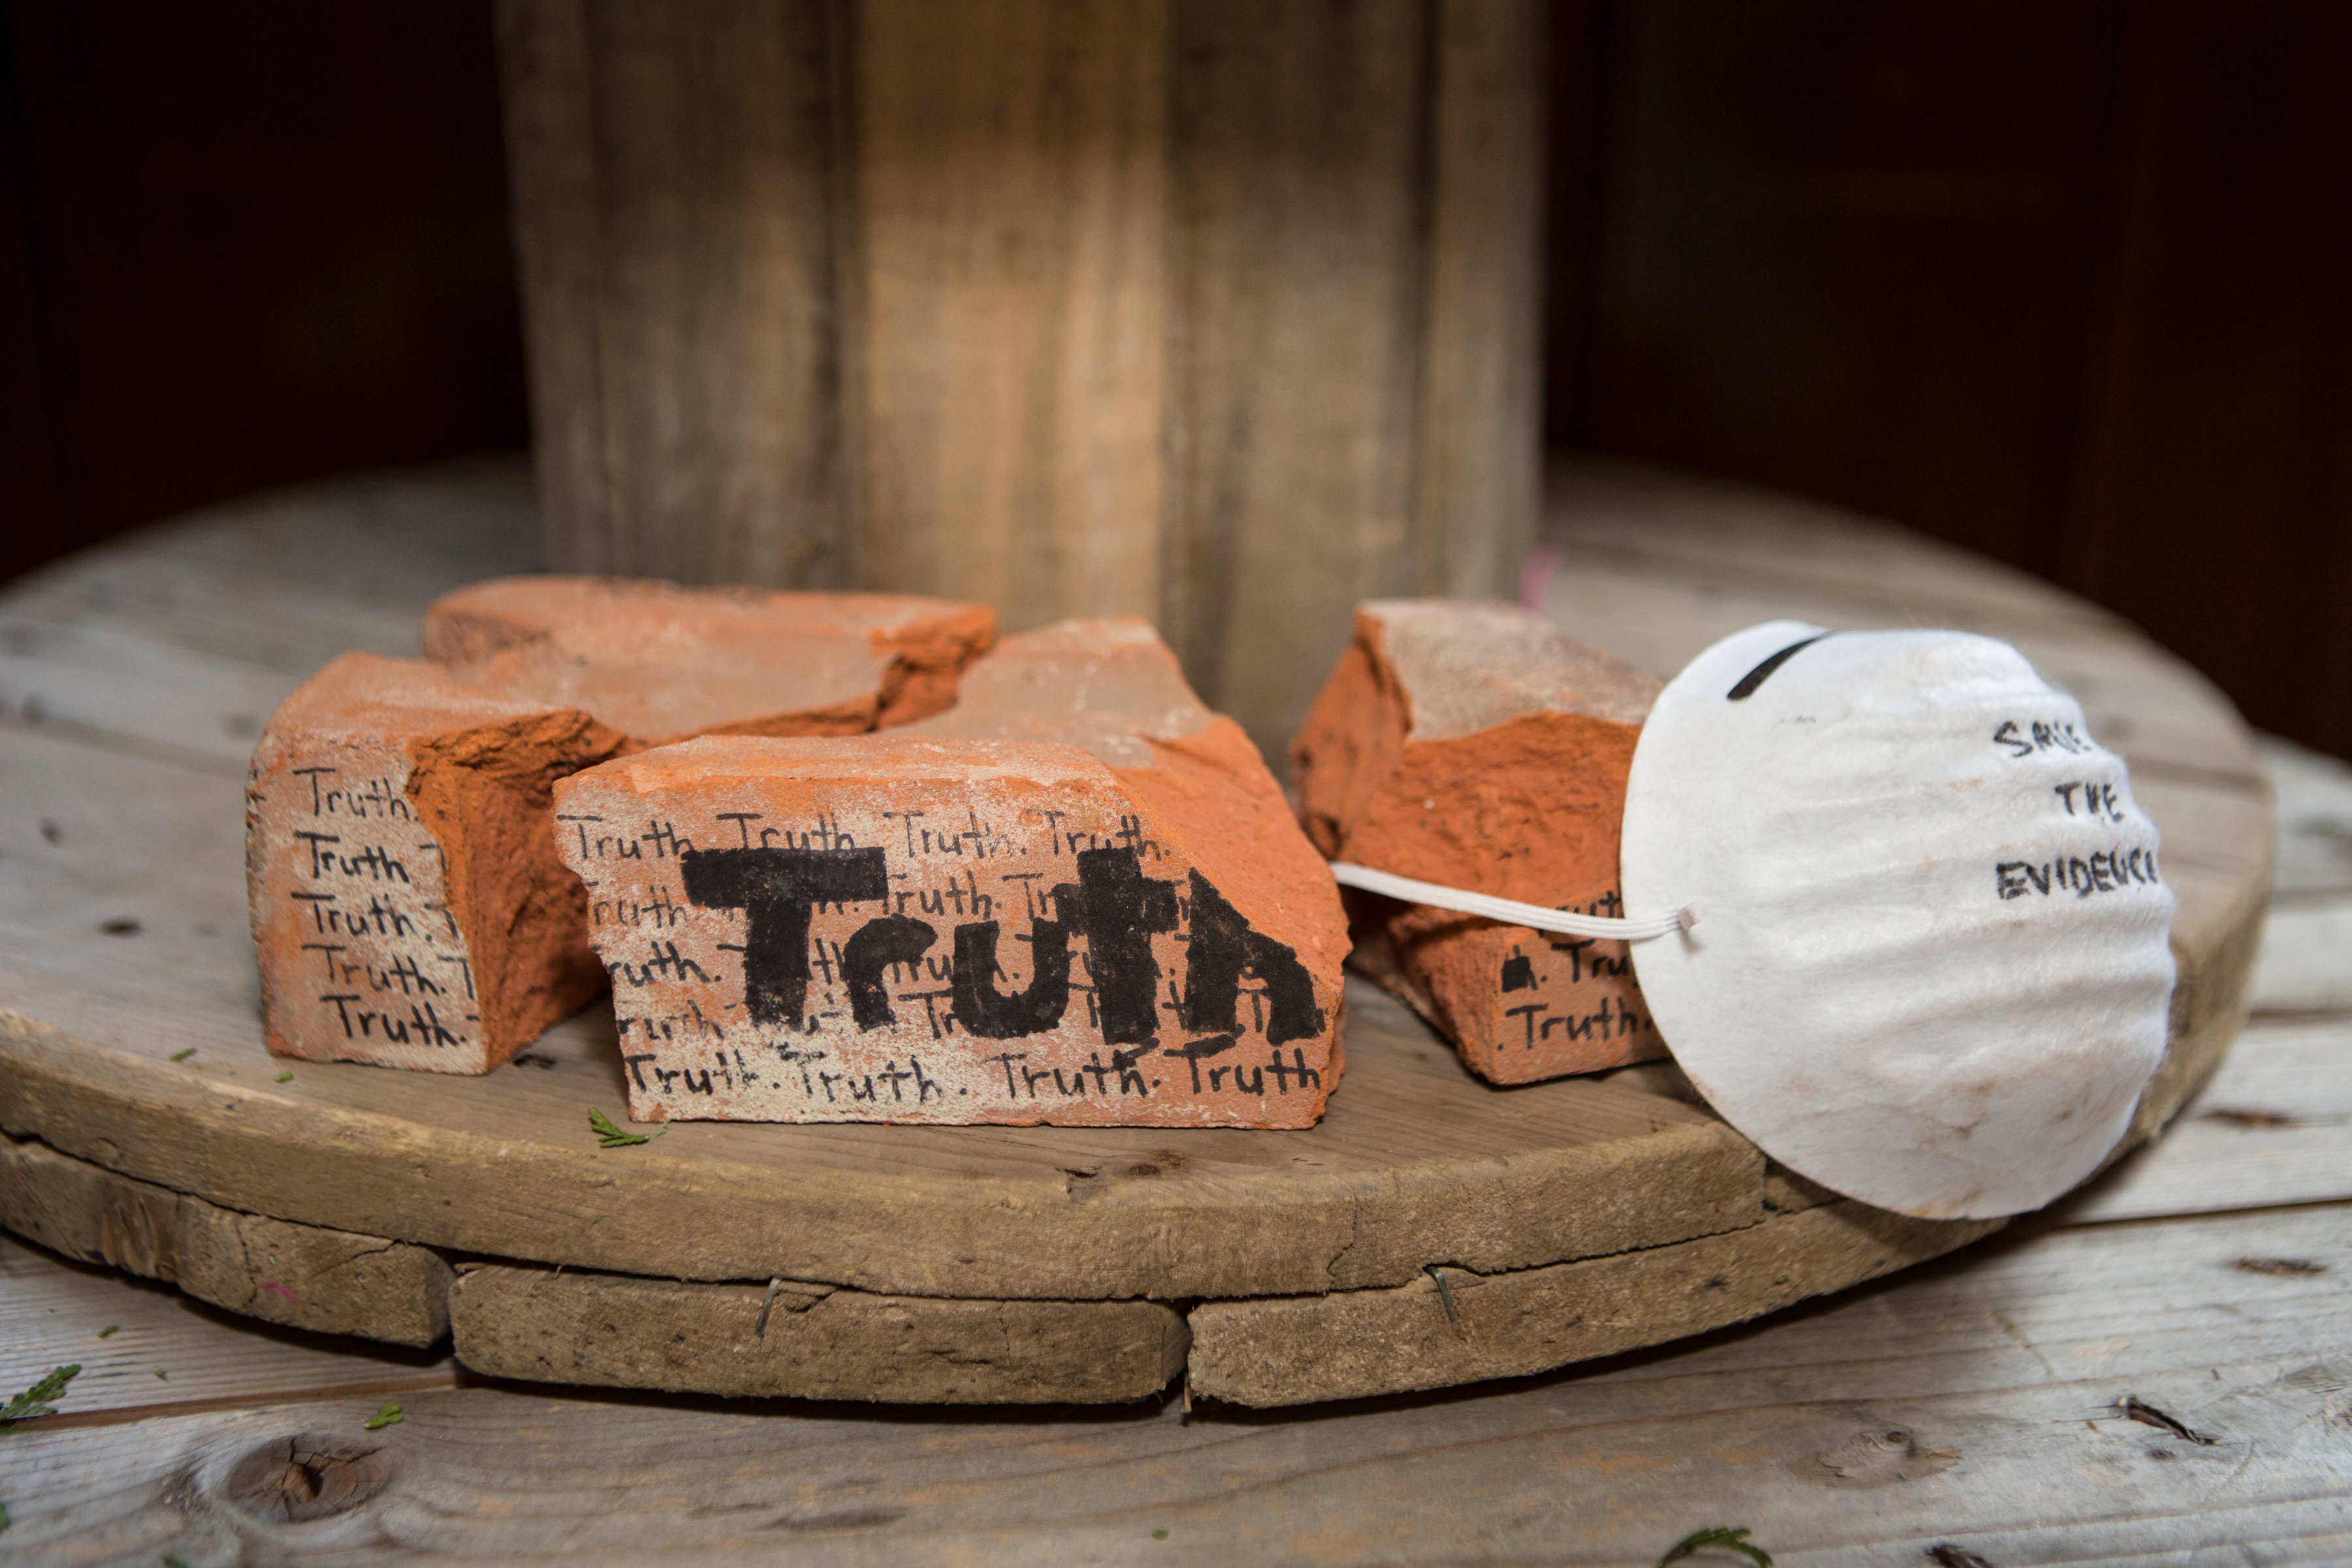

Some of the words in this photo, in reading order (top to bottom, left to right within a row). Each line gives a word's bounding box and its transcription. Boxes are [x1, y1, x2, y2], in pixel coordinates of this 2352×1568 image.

[293, 766, 419, 822] Truth.
[2054, 781, 2125, 823] THE
[556, 813, 695, 861] Truth
[883, 810, 1028, 860] Truth.
[290, 891, 433, 943] Truth.
[587, 879, 690, 929] ruth
[301, 944, 448, 996] Truth.
[589, 940, 721, 988] ruth.
[680, 845, 1323, 1046] Truth
[1550, 939, 1640, 990] Tru
[320, 993, 467, 1047] Truth.
[1163, 1036, 1322, 1097] Truth
